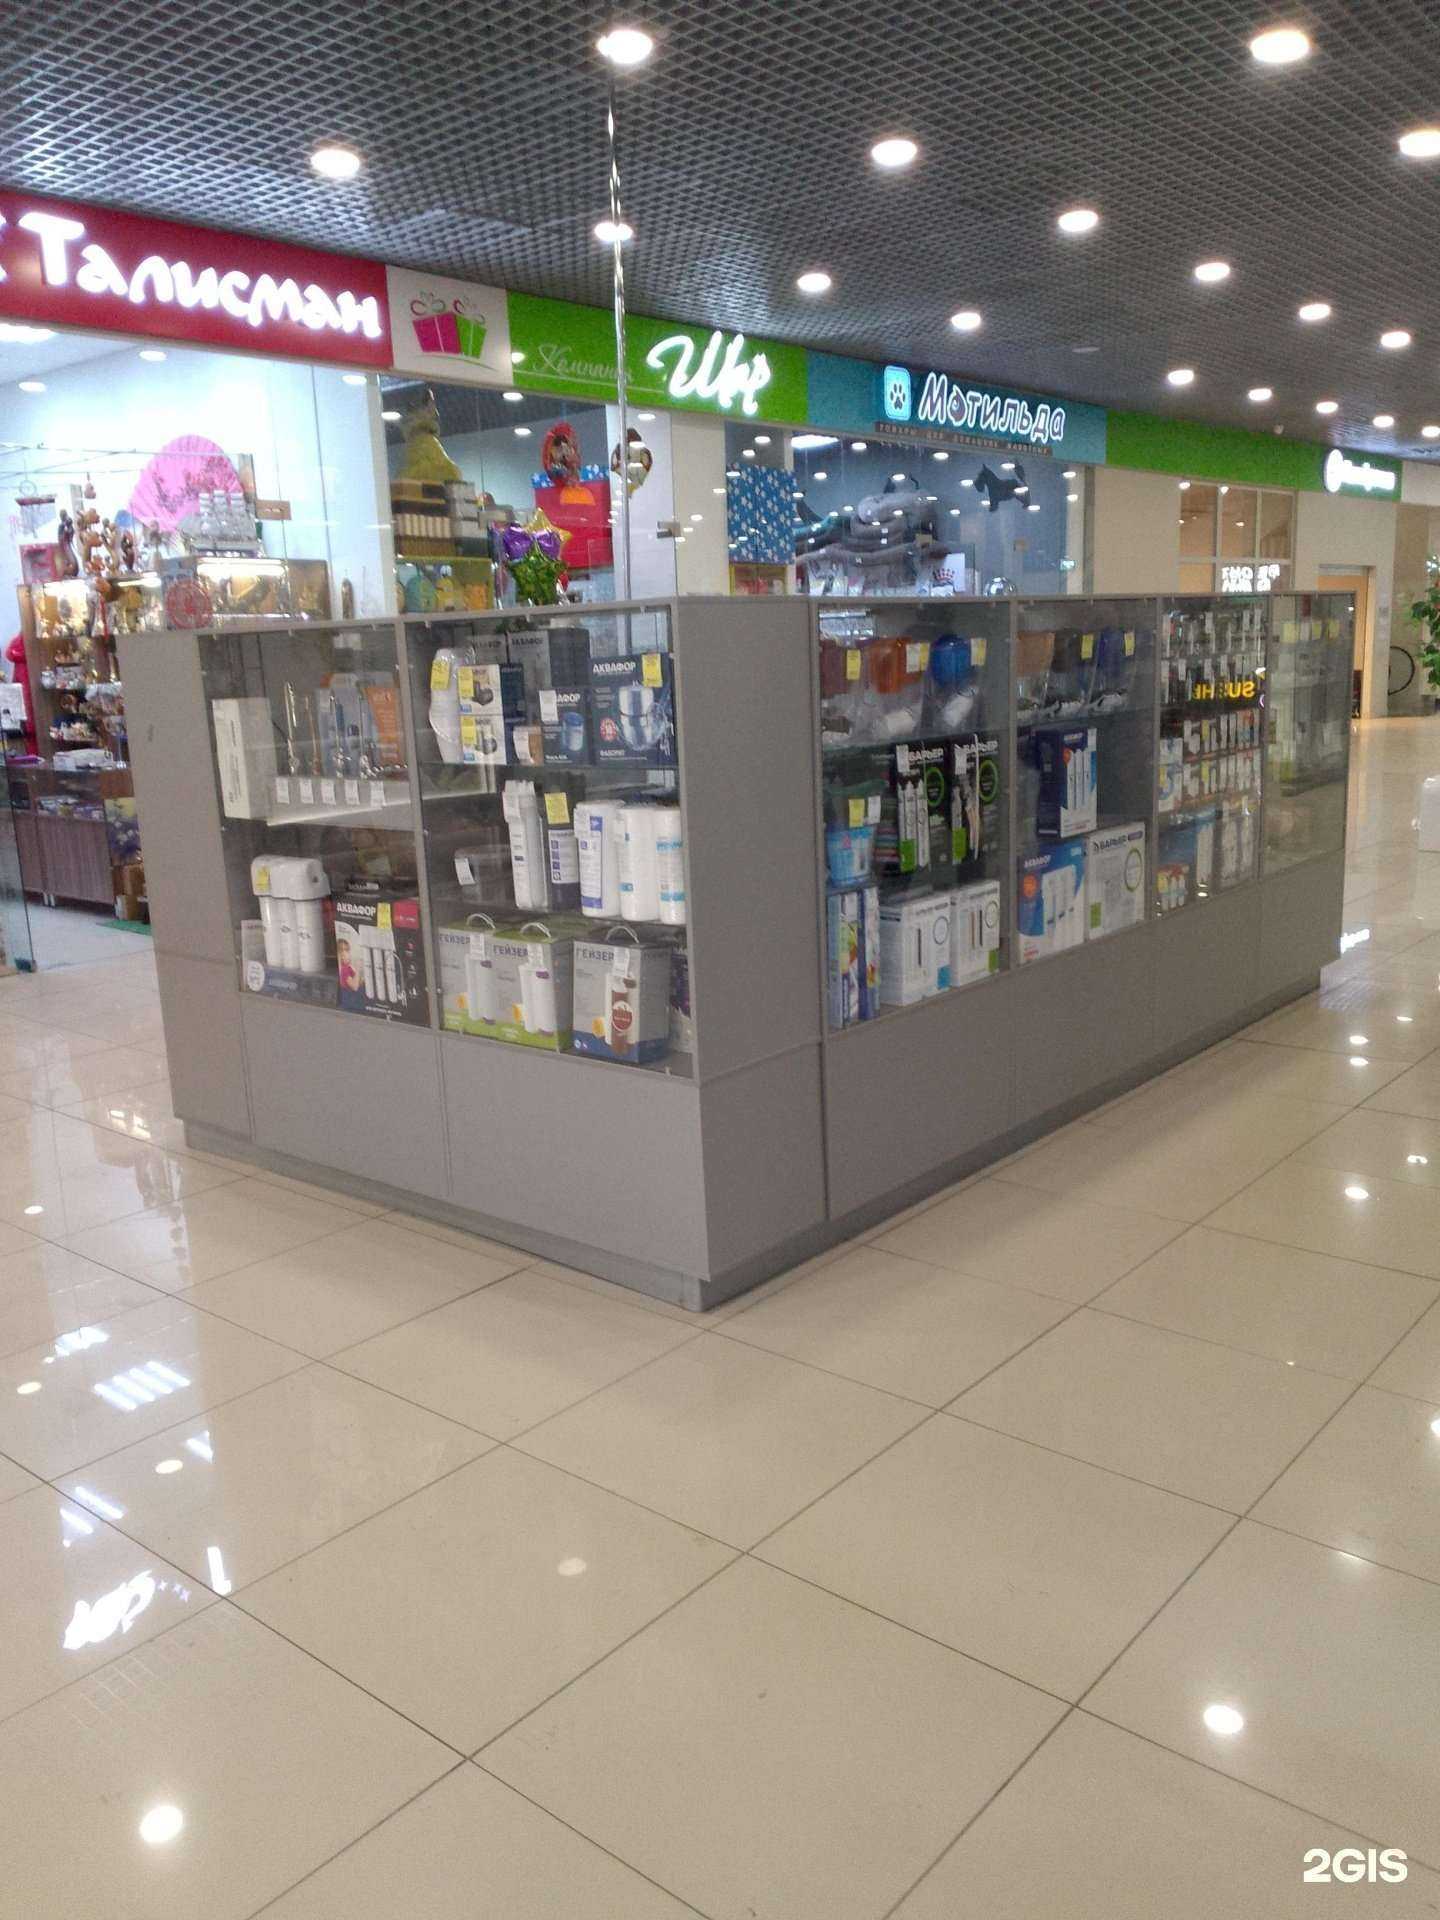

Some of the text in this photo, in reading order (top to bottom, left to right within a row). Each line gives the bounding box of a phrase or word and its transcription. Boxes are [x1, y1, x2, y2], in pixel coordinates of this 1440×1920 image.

[18, 211, 382, 338] Талисман
[593, 661, 636, 673] АКВАФОР
[336, 901, 376, 917] АКВАФОР
[439, 933, 471, 945] ГЕЙЗЕР
[493, 944, 528, 958] ГЕЙЗЕР
[577, 947, 615, 962] ГЕЙЗЕР
